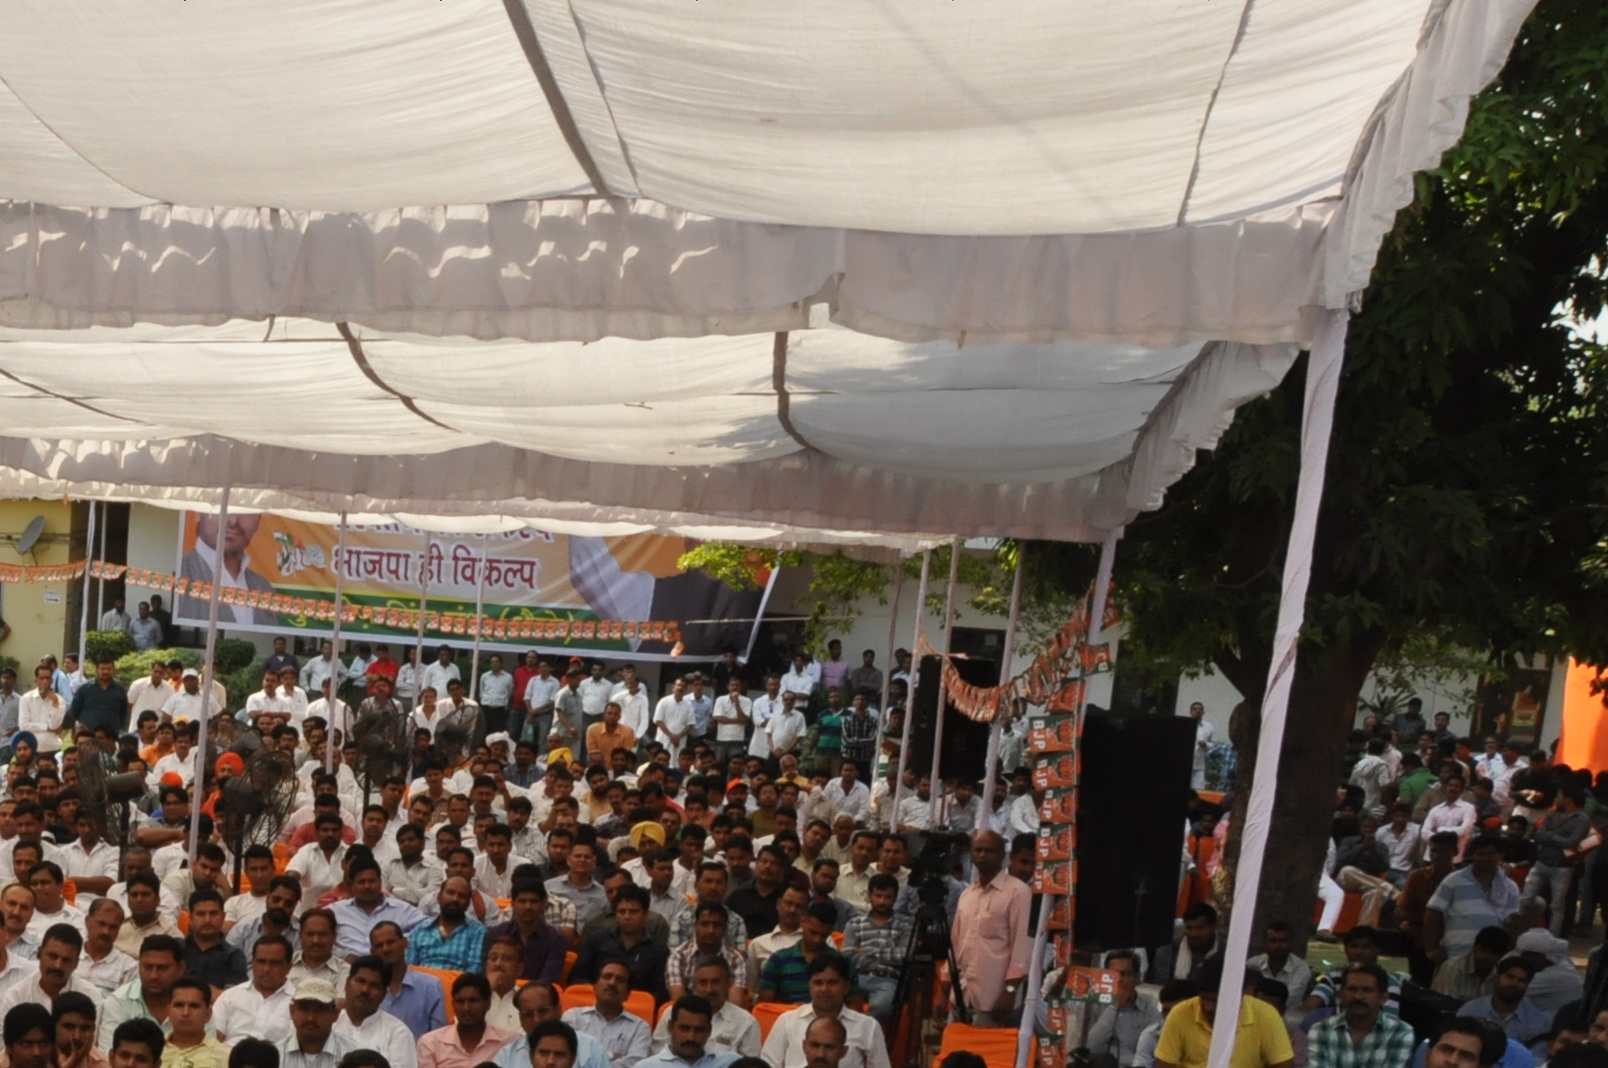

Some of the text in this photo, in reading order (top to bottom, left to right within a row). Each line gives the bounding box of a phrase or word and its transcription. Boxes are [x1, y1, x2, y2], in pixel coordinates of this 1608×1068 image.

[334, 547, 410, 581] भाजपा
[452, 544, 537, 588] विकल्प
[1032, 719, 1046, 750] BJP
[1037, 759, 1048, 788] BJP
[1039, 828, 1051, 858] BJP
[1099, 973, 1114, 1004] BJP
[1039, 1037, 1053, 1066] BJP
